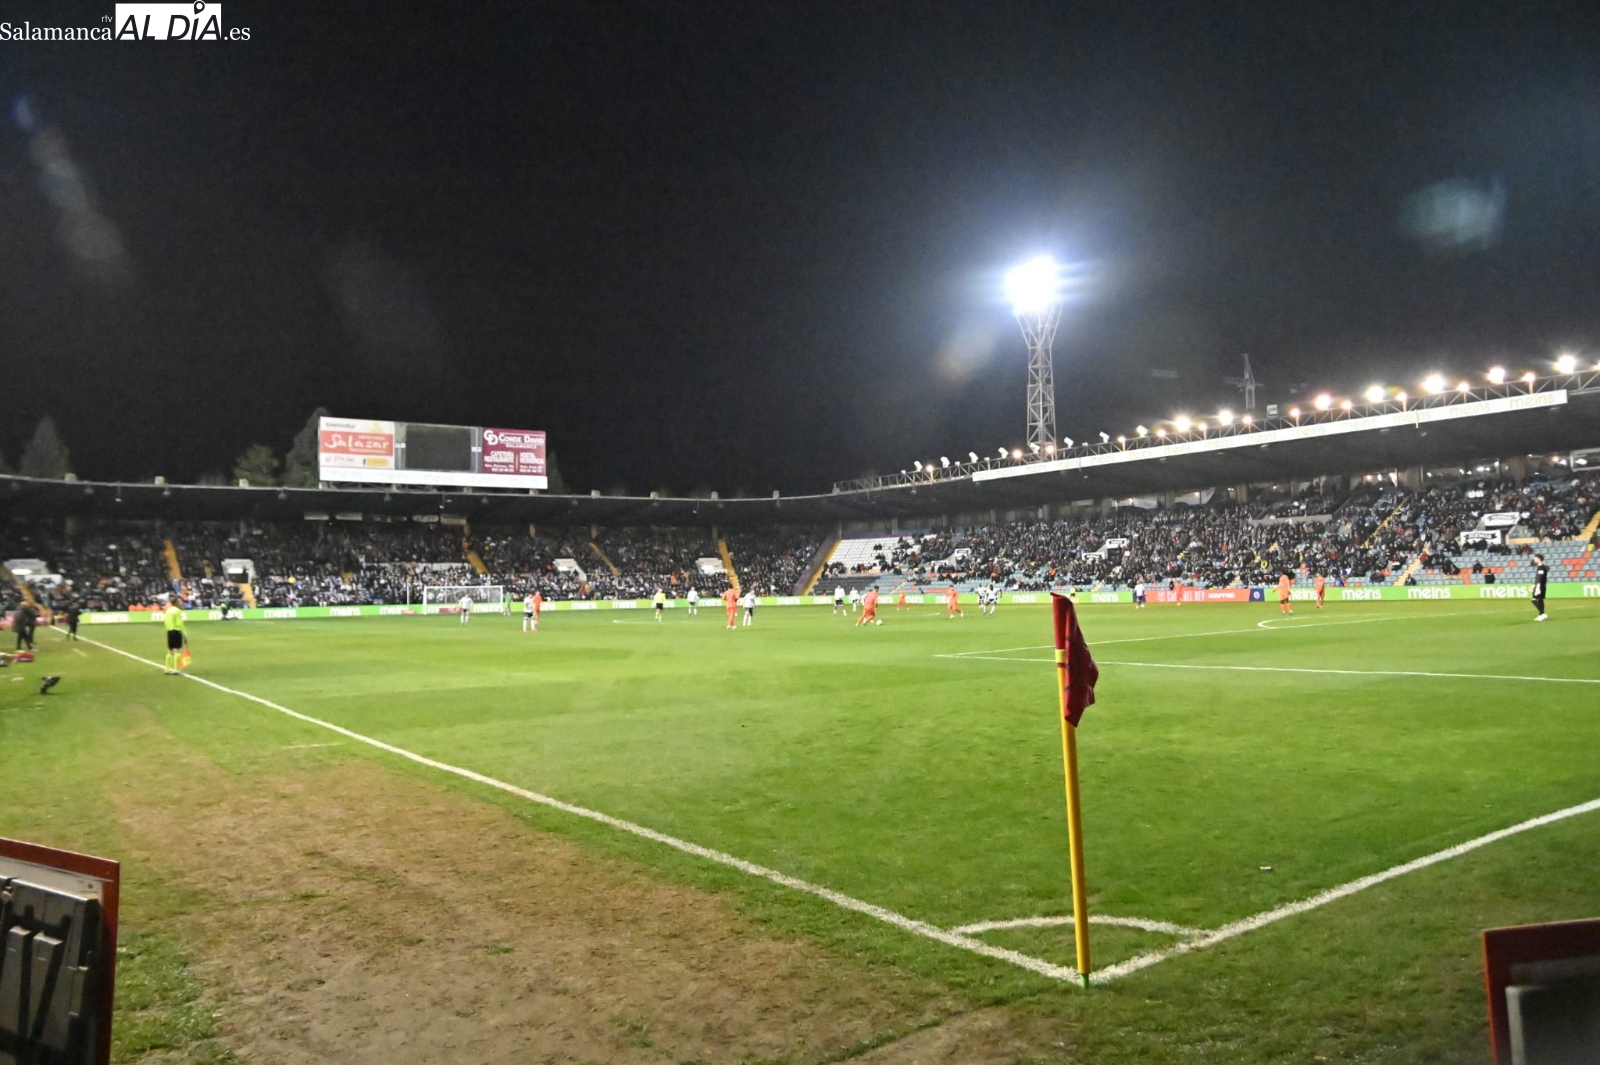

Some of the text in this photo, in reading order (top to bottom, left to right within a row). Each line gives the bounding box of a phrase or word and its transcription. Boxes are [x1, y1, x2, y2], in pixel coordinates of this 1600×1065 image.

[1510, 393, 1554, 409] meins
[1450, 402, 1490, 417] meins
[1340, 418, 1376, 431] meins
[1293, 426, 1325, 438] meins
[325, 434, 389, 449] Salazar
[1204, 439, 1233, 450] meins
[1247, 433, 1278, 445] meins
[1342, 588, 1381, 600] meins
[1407, 587, 1451, 599] meins
[1479, 584, 1528, 598] meins
[1091, 593, 1119, 603] meins
[264, 609, 296, 619] meins
[330, 607, 360, 617] meins
